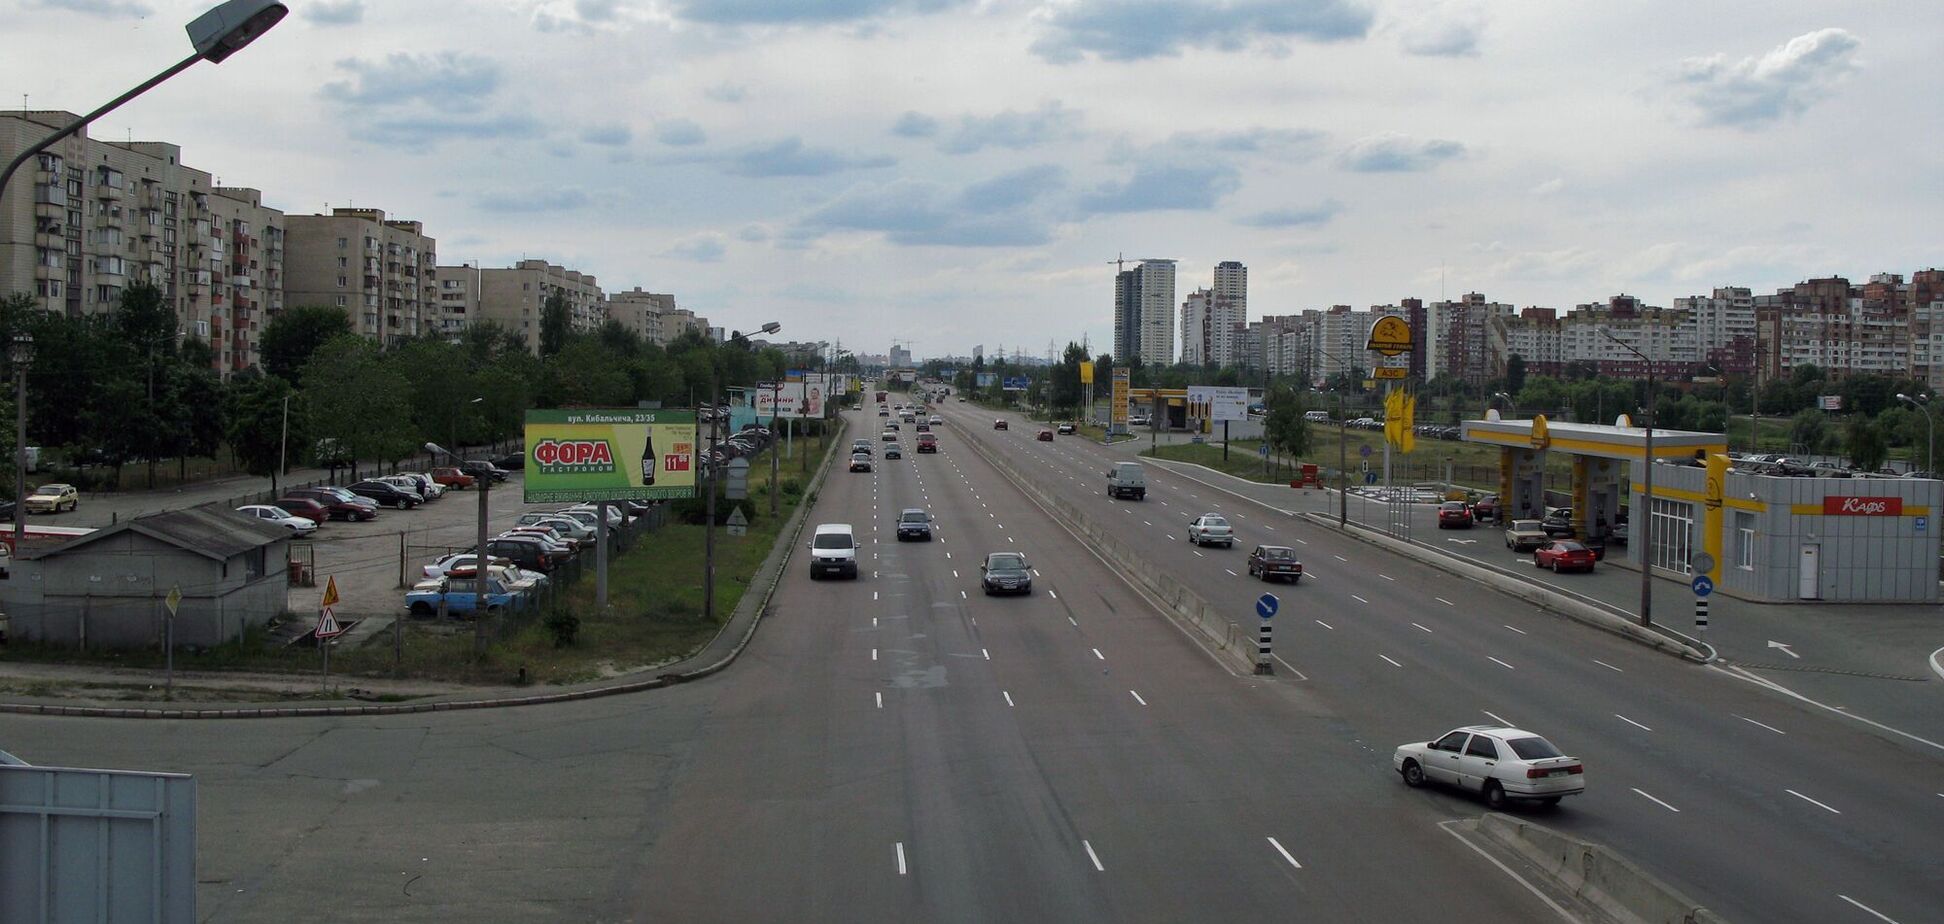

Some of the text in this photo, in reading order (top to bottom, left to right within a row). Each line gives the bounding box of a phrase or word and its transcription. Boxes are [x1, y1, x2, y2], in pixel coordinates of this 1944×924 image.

[567, 414, 656, 424] вул. Кибальчича, 23/35
[535, 440, 613, 466] ФОРА
[542, 465, 613, 473] ГАСТРОНОМ
